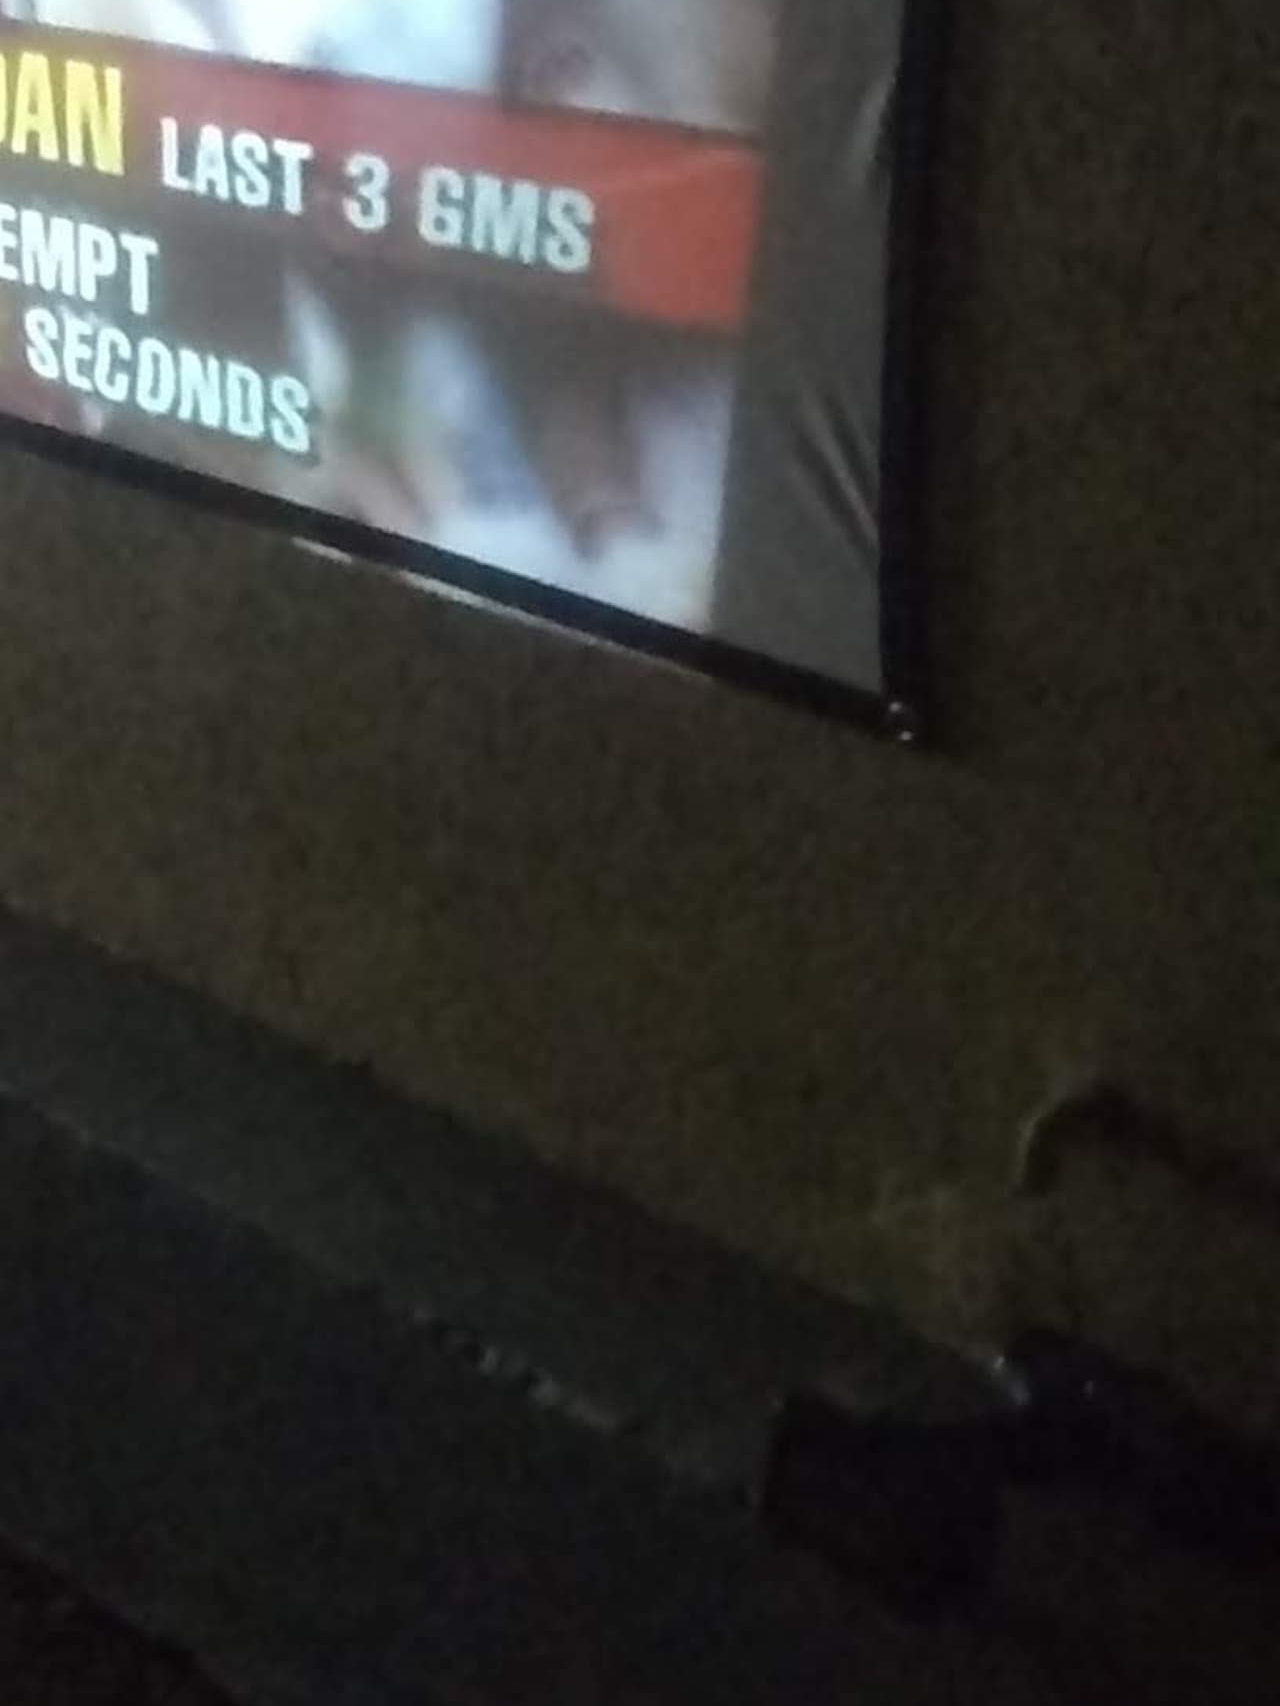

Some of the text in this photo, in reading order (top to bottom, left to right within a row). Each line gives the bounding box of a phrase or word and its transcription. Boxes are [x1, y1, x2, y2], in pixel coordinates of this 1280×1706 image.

[159, 117, 313, 217] LAST
[344, 154, 391, 232] 3
[417, 166, 597, 274] GMS
[24, 308, 312, 455] SECONDS
